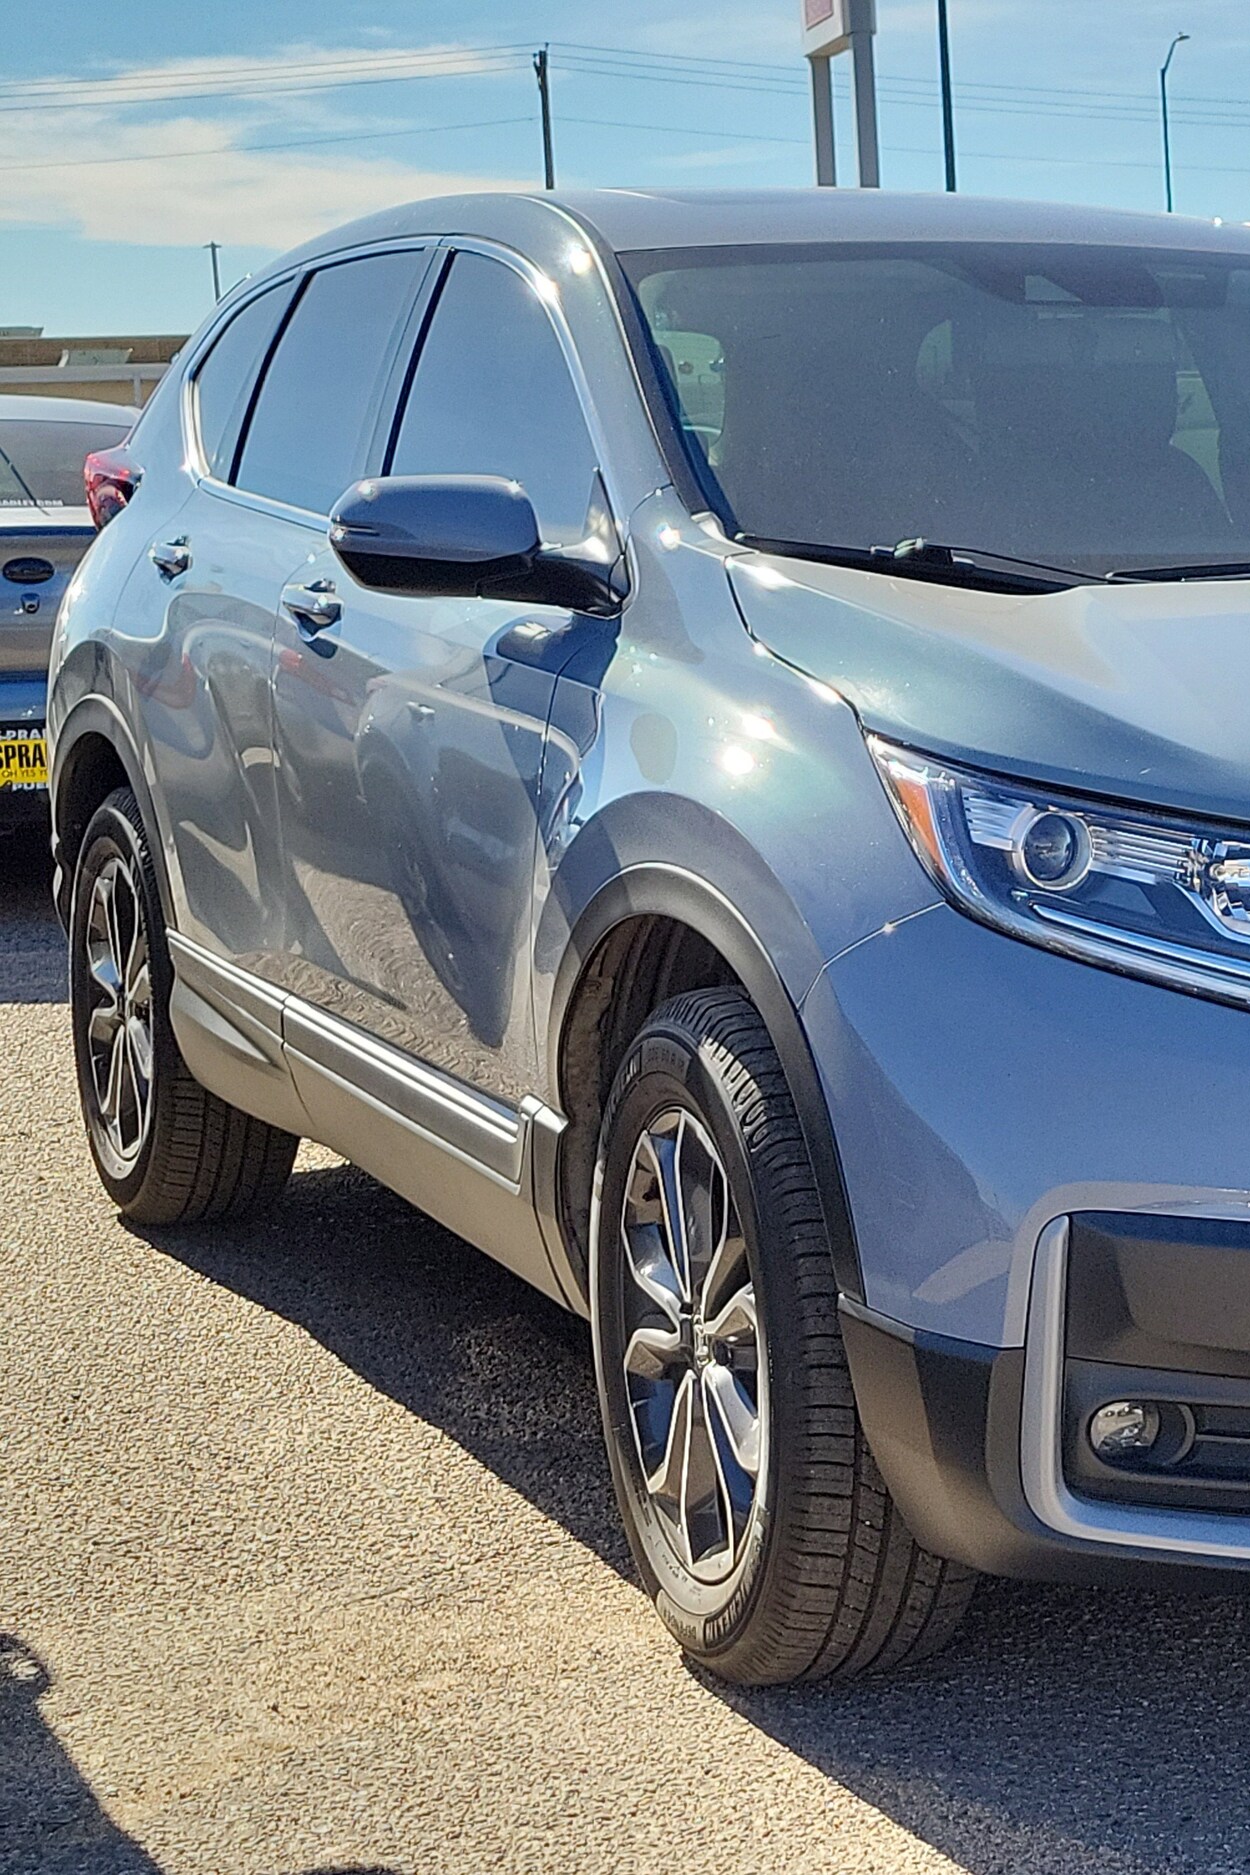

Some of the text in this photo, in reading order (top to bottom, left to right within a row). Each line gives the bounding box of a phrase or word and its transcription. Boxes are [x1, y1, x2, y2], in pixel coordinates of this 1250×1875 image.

[0, 728, 47, 741] PRA
[0, 743, 48, 769] PRA
[21, 768, 36, 778] YES
